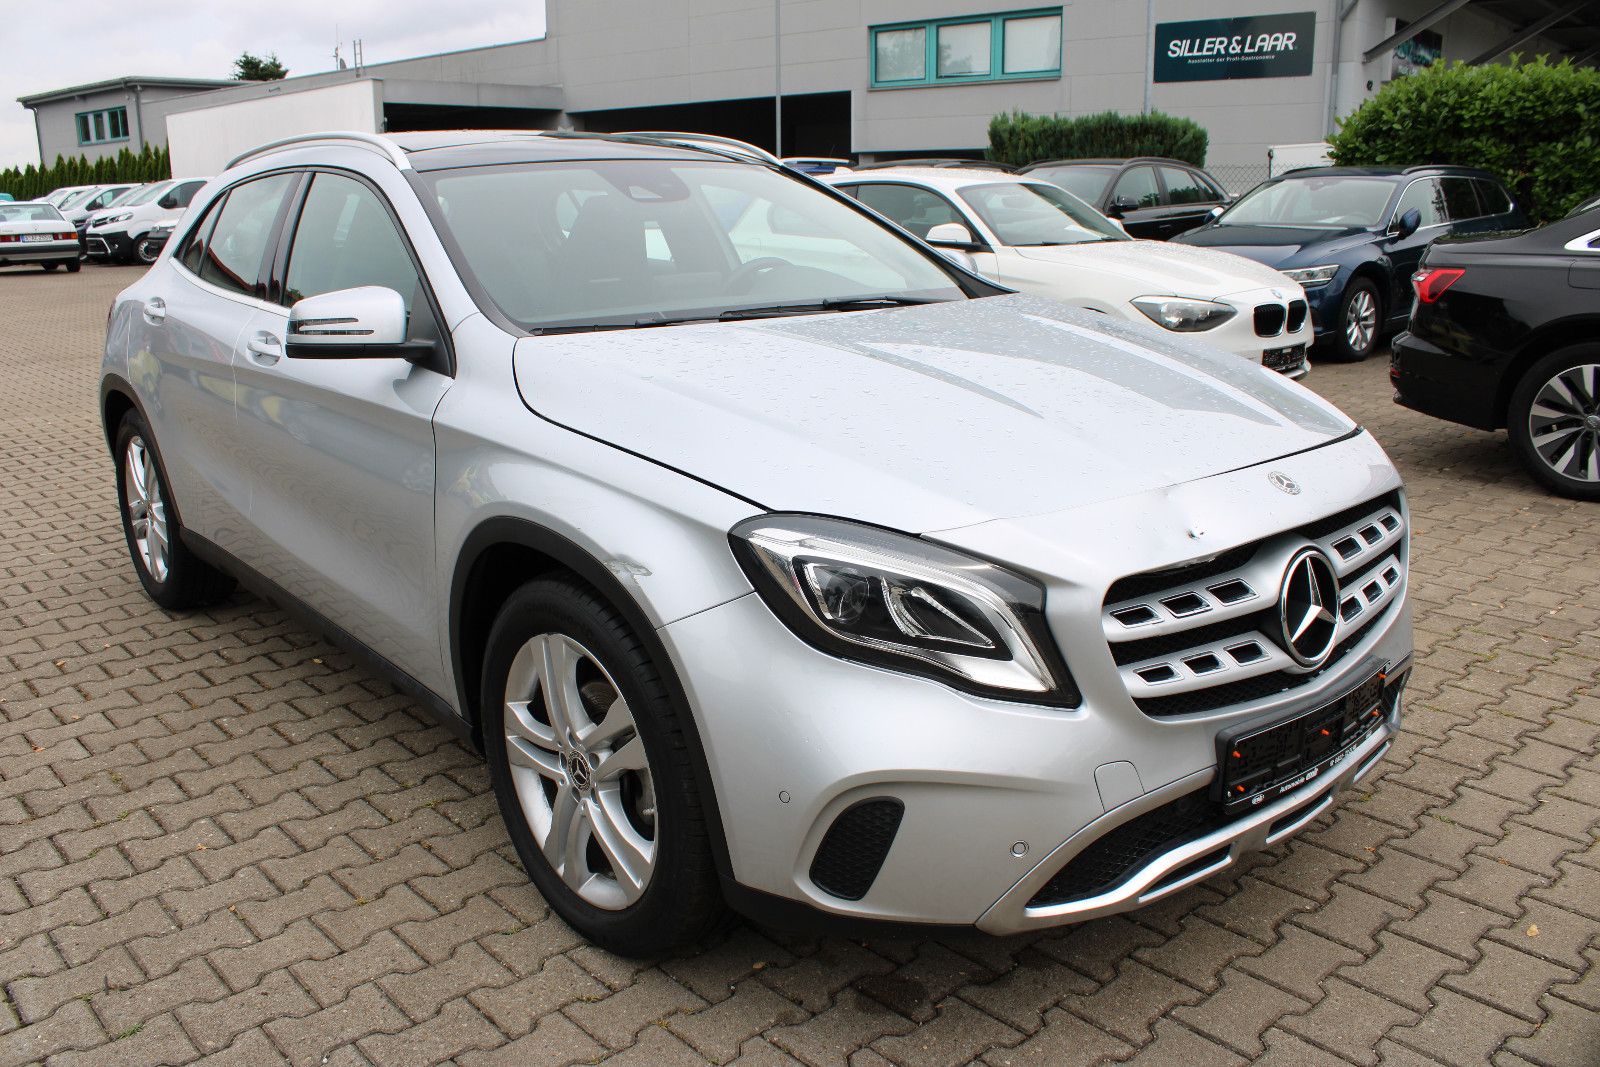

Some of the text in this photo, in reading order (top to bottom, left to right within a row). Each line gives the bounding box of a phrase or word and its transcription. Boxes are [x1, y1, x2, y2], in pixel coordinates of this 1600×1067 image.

[1167, 32, 1297, 57] SILLER & LAAR
